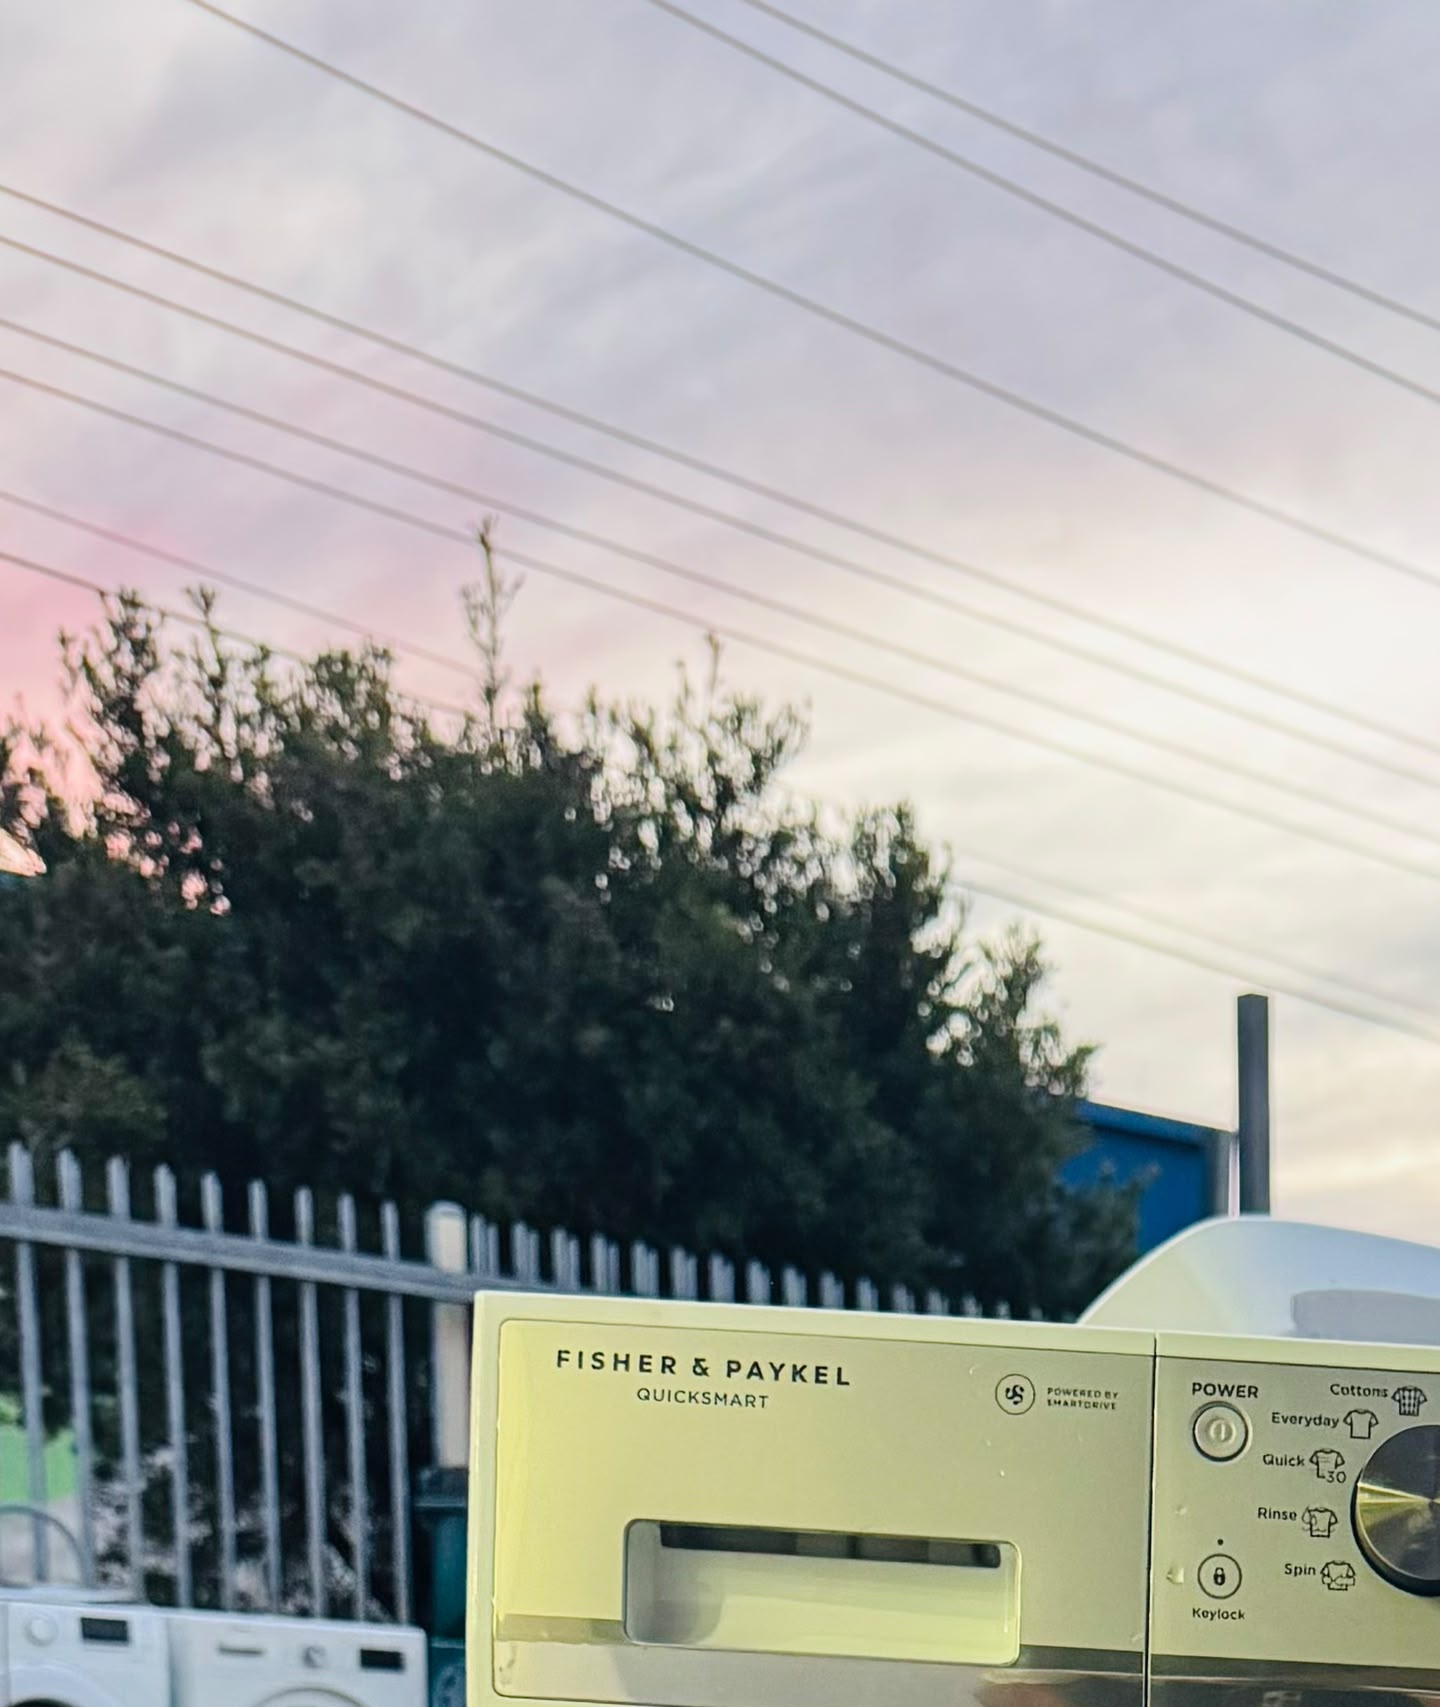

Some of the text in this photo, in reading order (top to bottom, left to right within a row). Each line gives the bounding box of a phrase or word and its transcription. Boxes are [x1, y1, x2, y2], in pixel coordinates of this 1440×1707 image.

[556, 1349, 851, 1386] FISHER & PAYKEL
[636, 1388, 769, 1408] QUICKSMART
[1047, 1387, 1118, 1399] POWERED BY
[1191, 1382, 1259, 1399] POWER
[1330, 1384, 1388, 1398] Cottons
[1271, 1412, 1340, 1429] Everyday
[1262, 1453, 1305, 1468] Quick
[1326, 1470, 1347, 1484] 30
[1257, 1507, 1297, 1521] Rinse
[1284, 1562, 1316, 1579] Spin
[1191, 1607, 1245, 1622] Keylock
